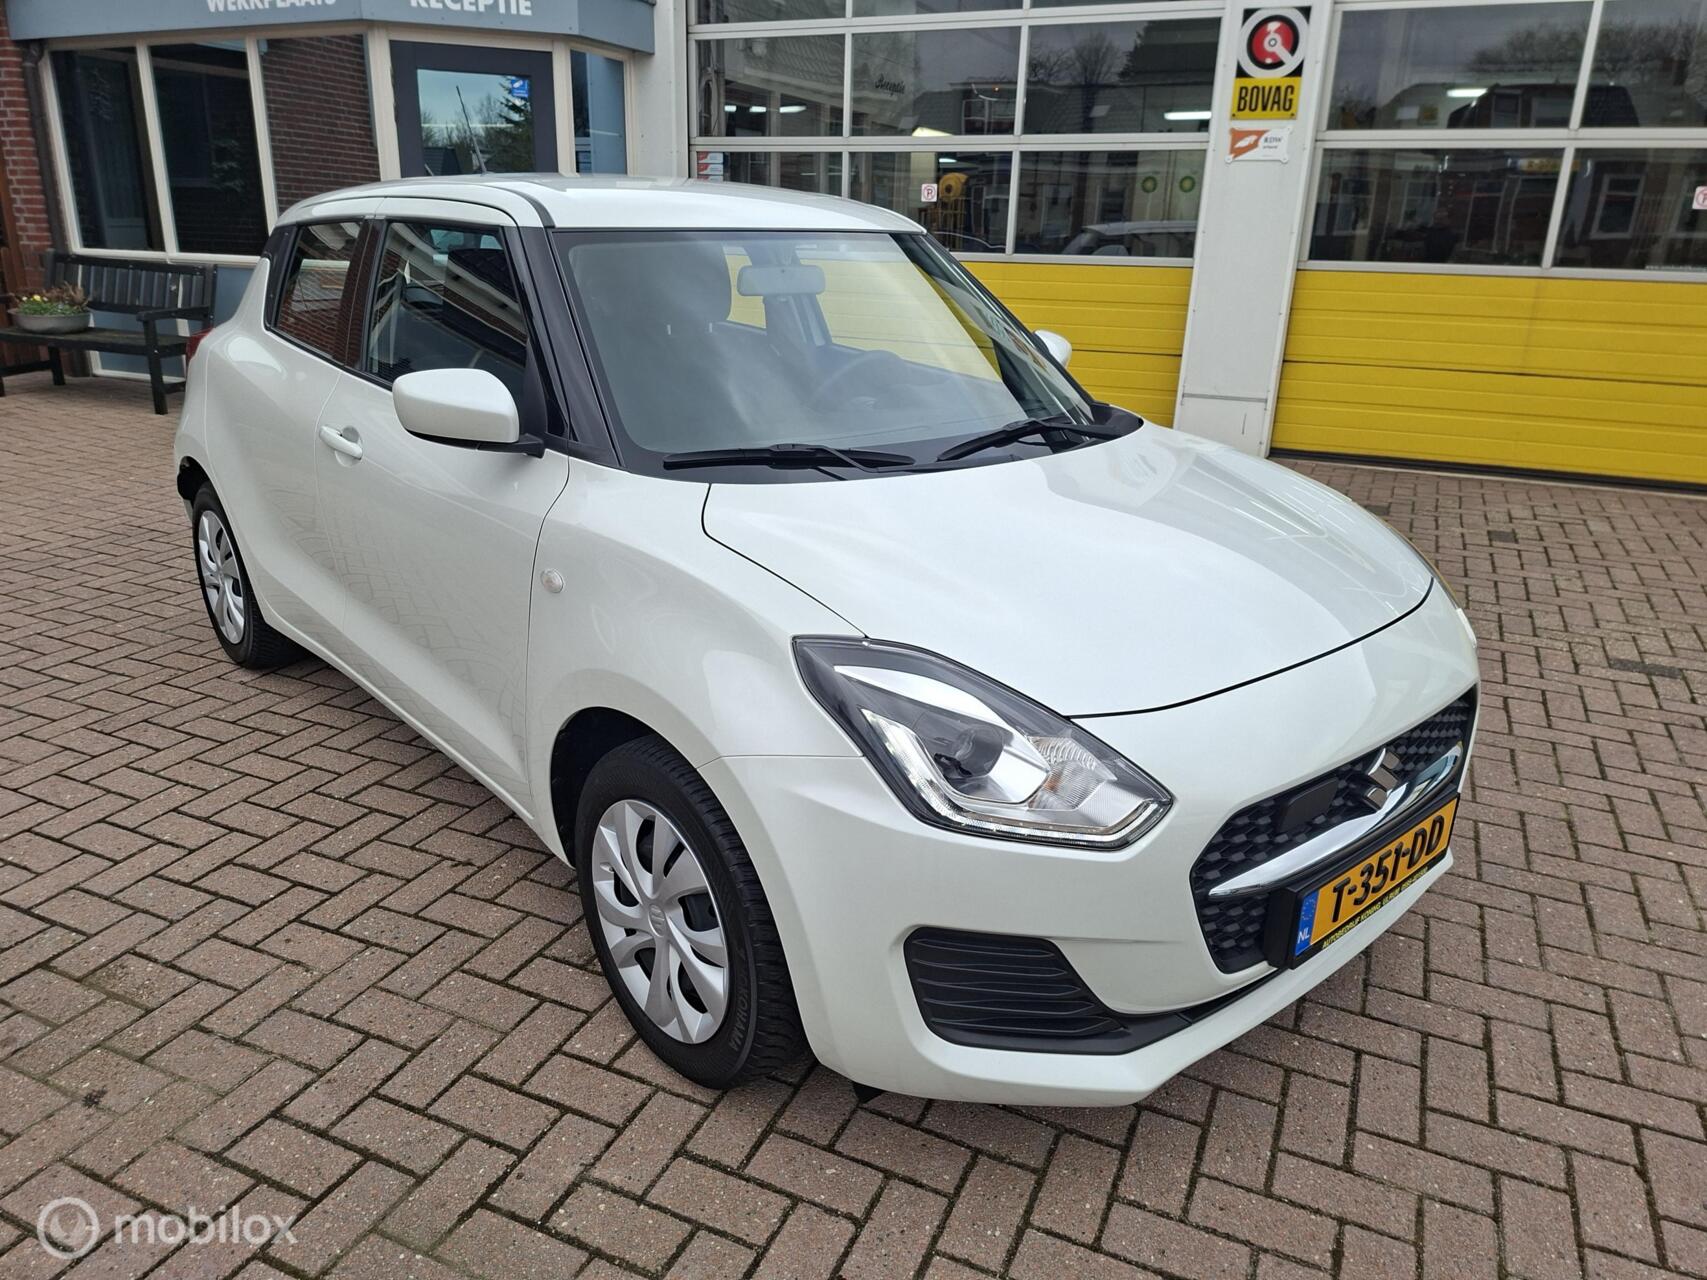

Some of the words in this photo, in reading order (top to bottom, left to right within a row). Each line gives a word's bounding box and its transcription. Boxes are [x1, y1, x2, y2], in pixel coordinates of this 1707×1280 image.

[1237, 84, 1295, 112] BOVAG
[1331, 814, 1445, 923] T-351-DD
[1297, 926, 1310, 944] NL
